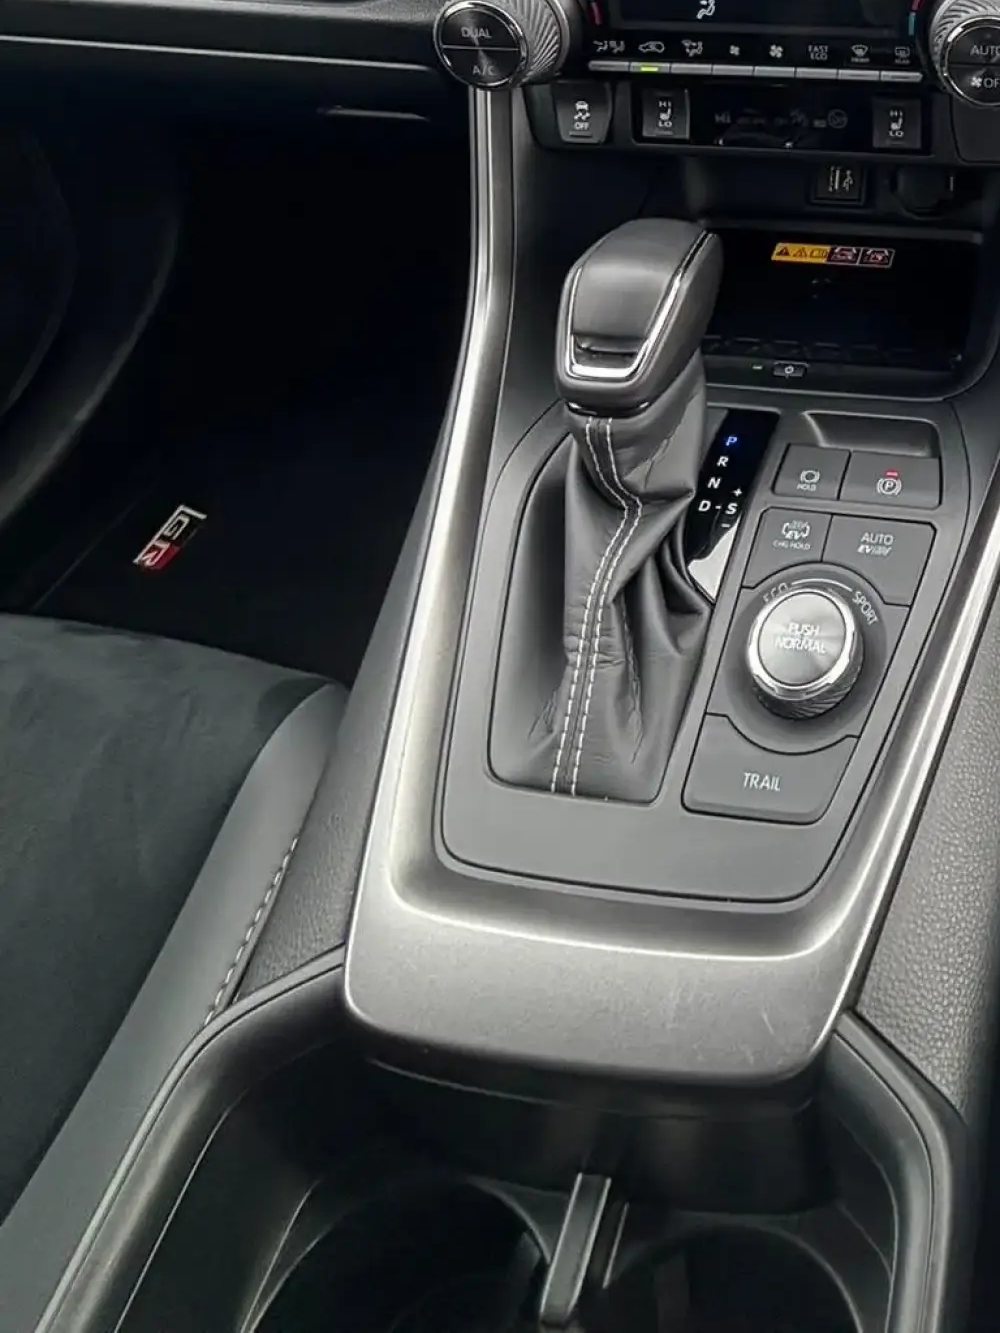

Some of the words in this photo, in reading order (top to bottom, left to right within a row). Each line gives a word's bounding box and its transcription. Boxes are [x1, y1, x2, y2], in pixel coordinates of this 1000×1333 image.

[460, 26, 492, 39] DUAL
[808, 45, 828, 53] FAST
[810, 52, 828, 60] ECO
[472, 65, 497, 76] A/C
[574, 122, 590, 130] OFF
[658, 120, 673, 128] LO
[726, 436, 738, 446] P
[716, 456, 729, 467] R
[707, 476, 721, 489] N
[698, 499, 712, 512] D
[725, 502, 738, 515] S
[860, 532, 894, 546] AUTO
[852, 591, 878, 626] SPORT
[788, 622, 820, 636] PUSH
[775, 636, 826, 654] NORMAL
[744, 772, 780, 792] TRAIL
